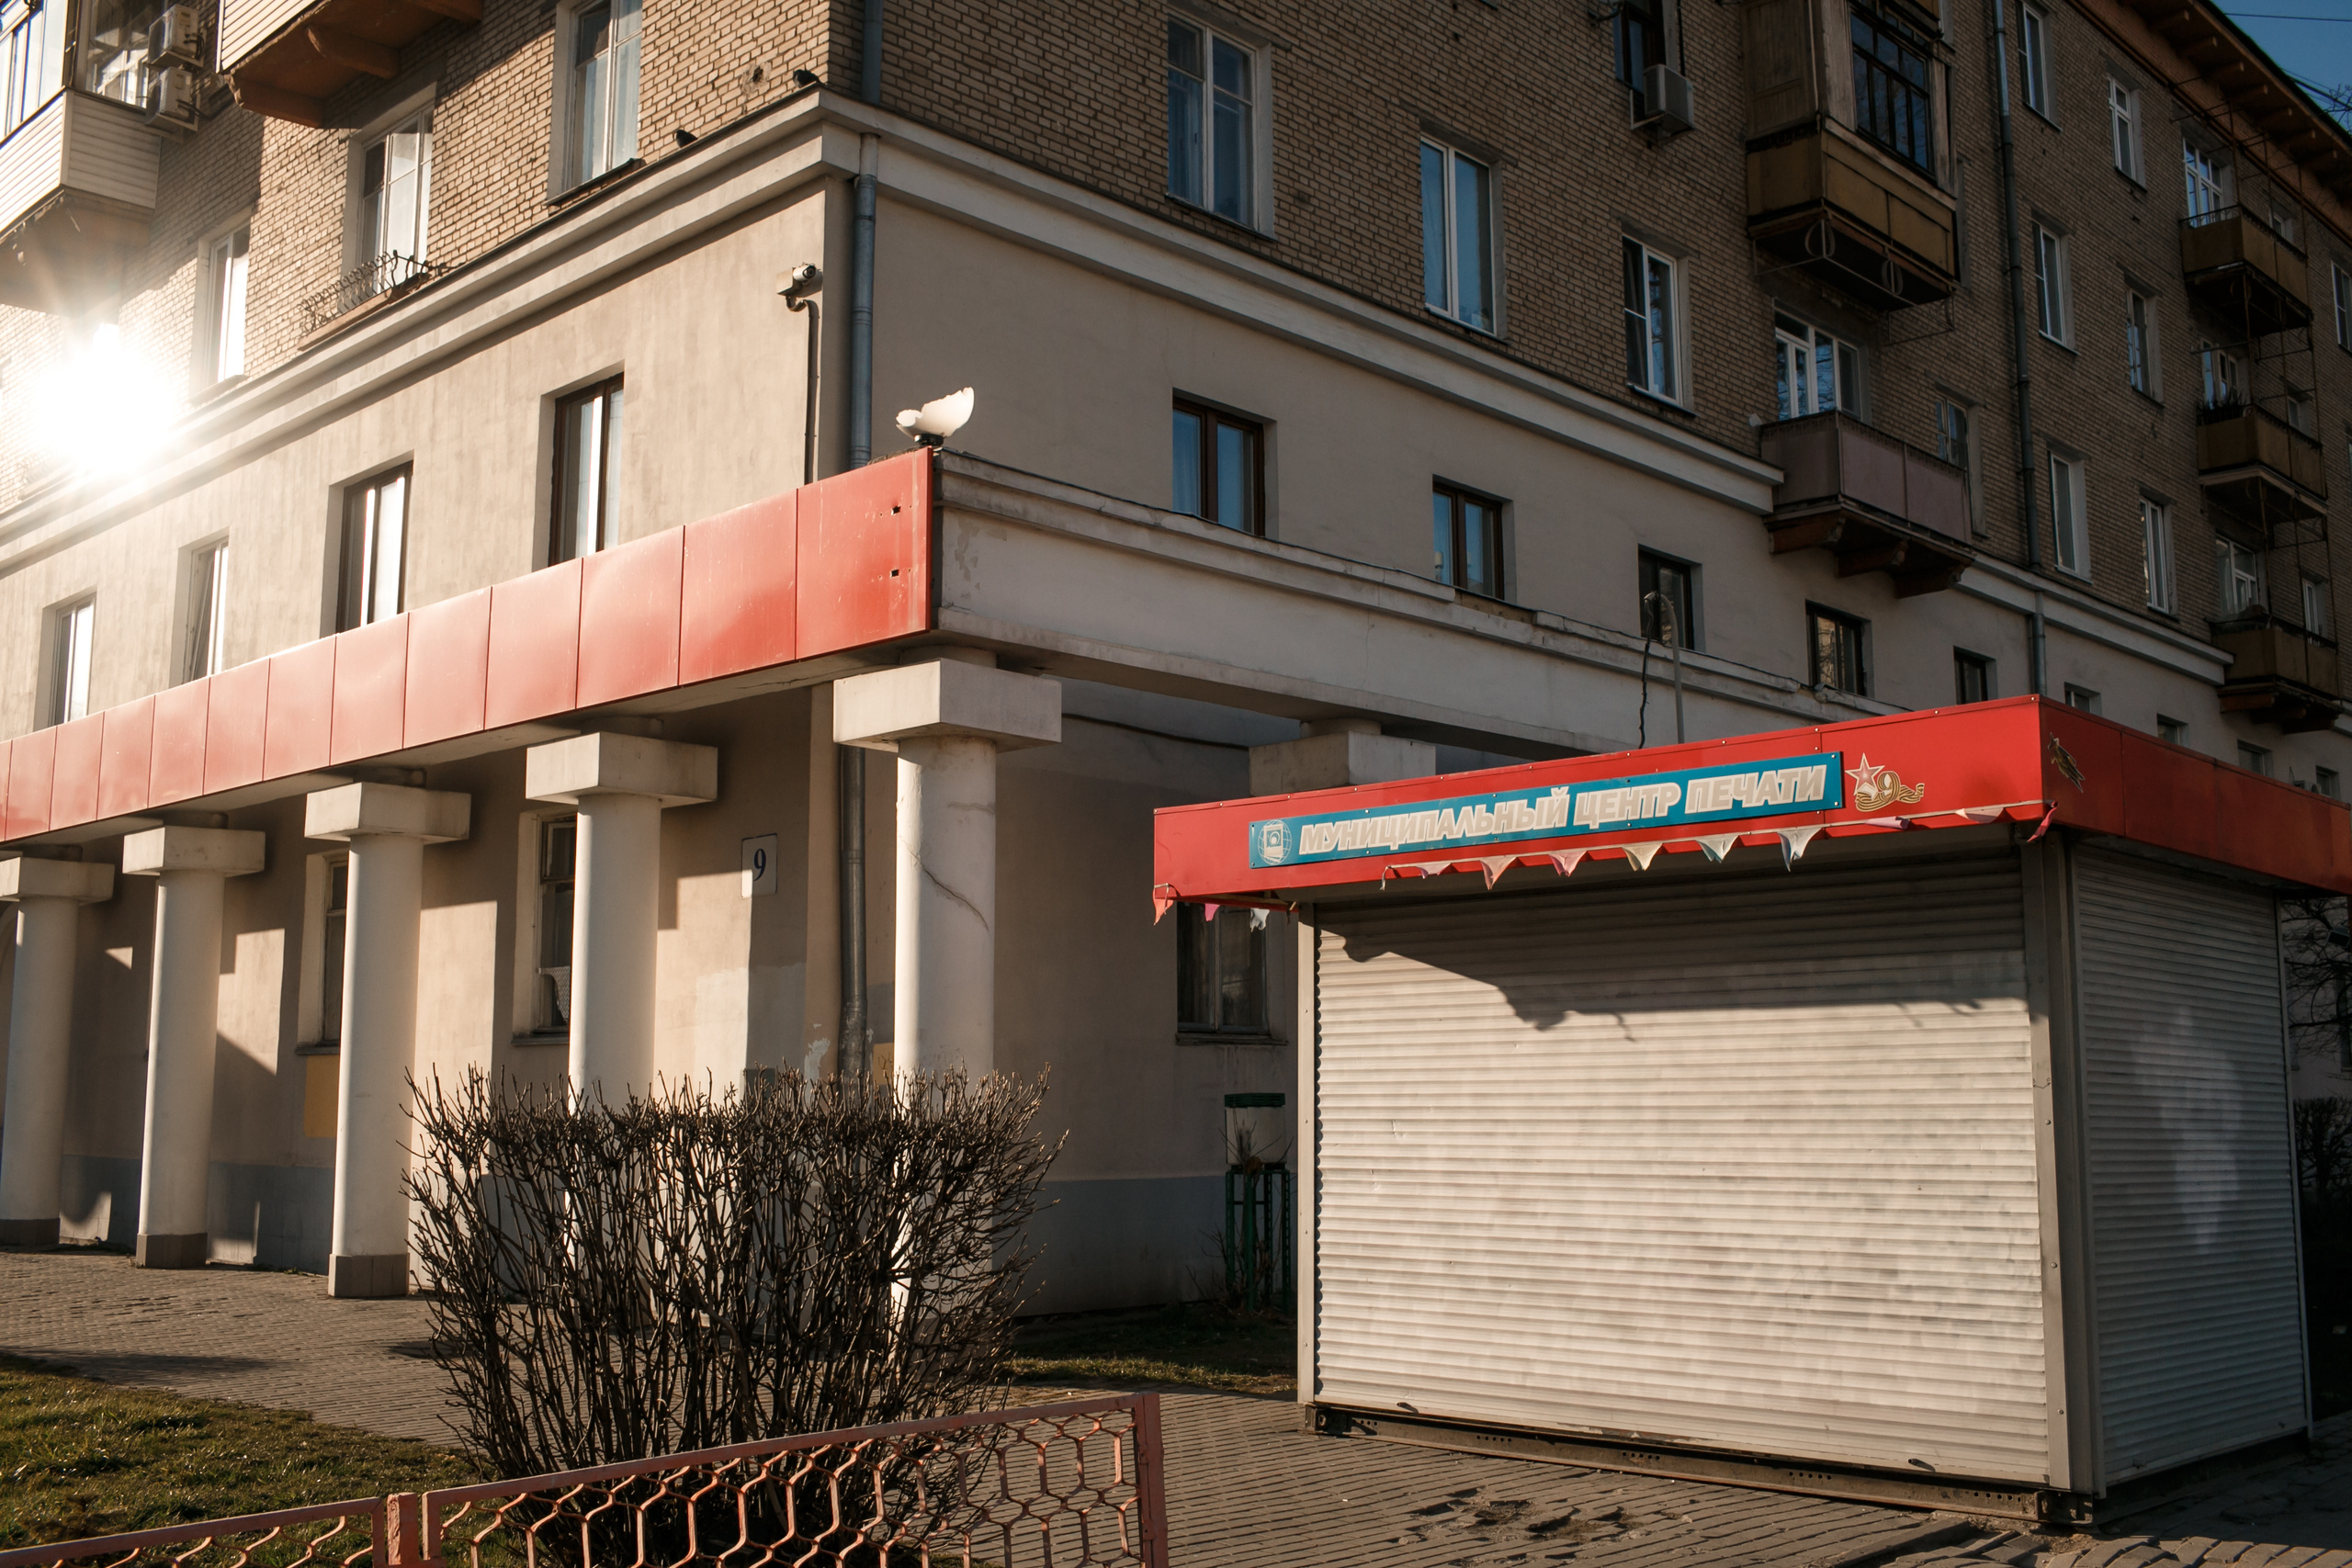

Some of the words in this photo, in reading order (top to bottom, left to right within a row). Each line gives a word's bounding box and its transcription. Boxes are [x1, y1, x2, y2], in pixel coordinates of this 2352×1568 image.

[1298, 786, 1570, 851] МУНИЦИПАЛЬНЫЙ
[1573, 782, 1681, 829] ЦЕНТР
[1685, 764, 1826, 814] ПЕЧАТИ
[753, 848, 767, 882] 9
